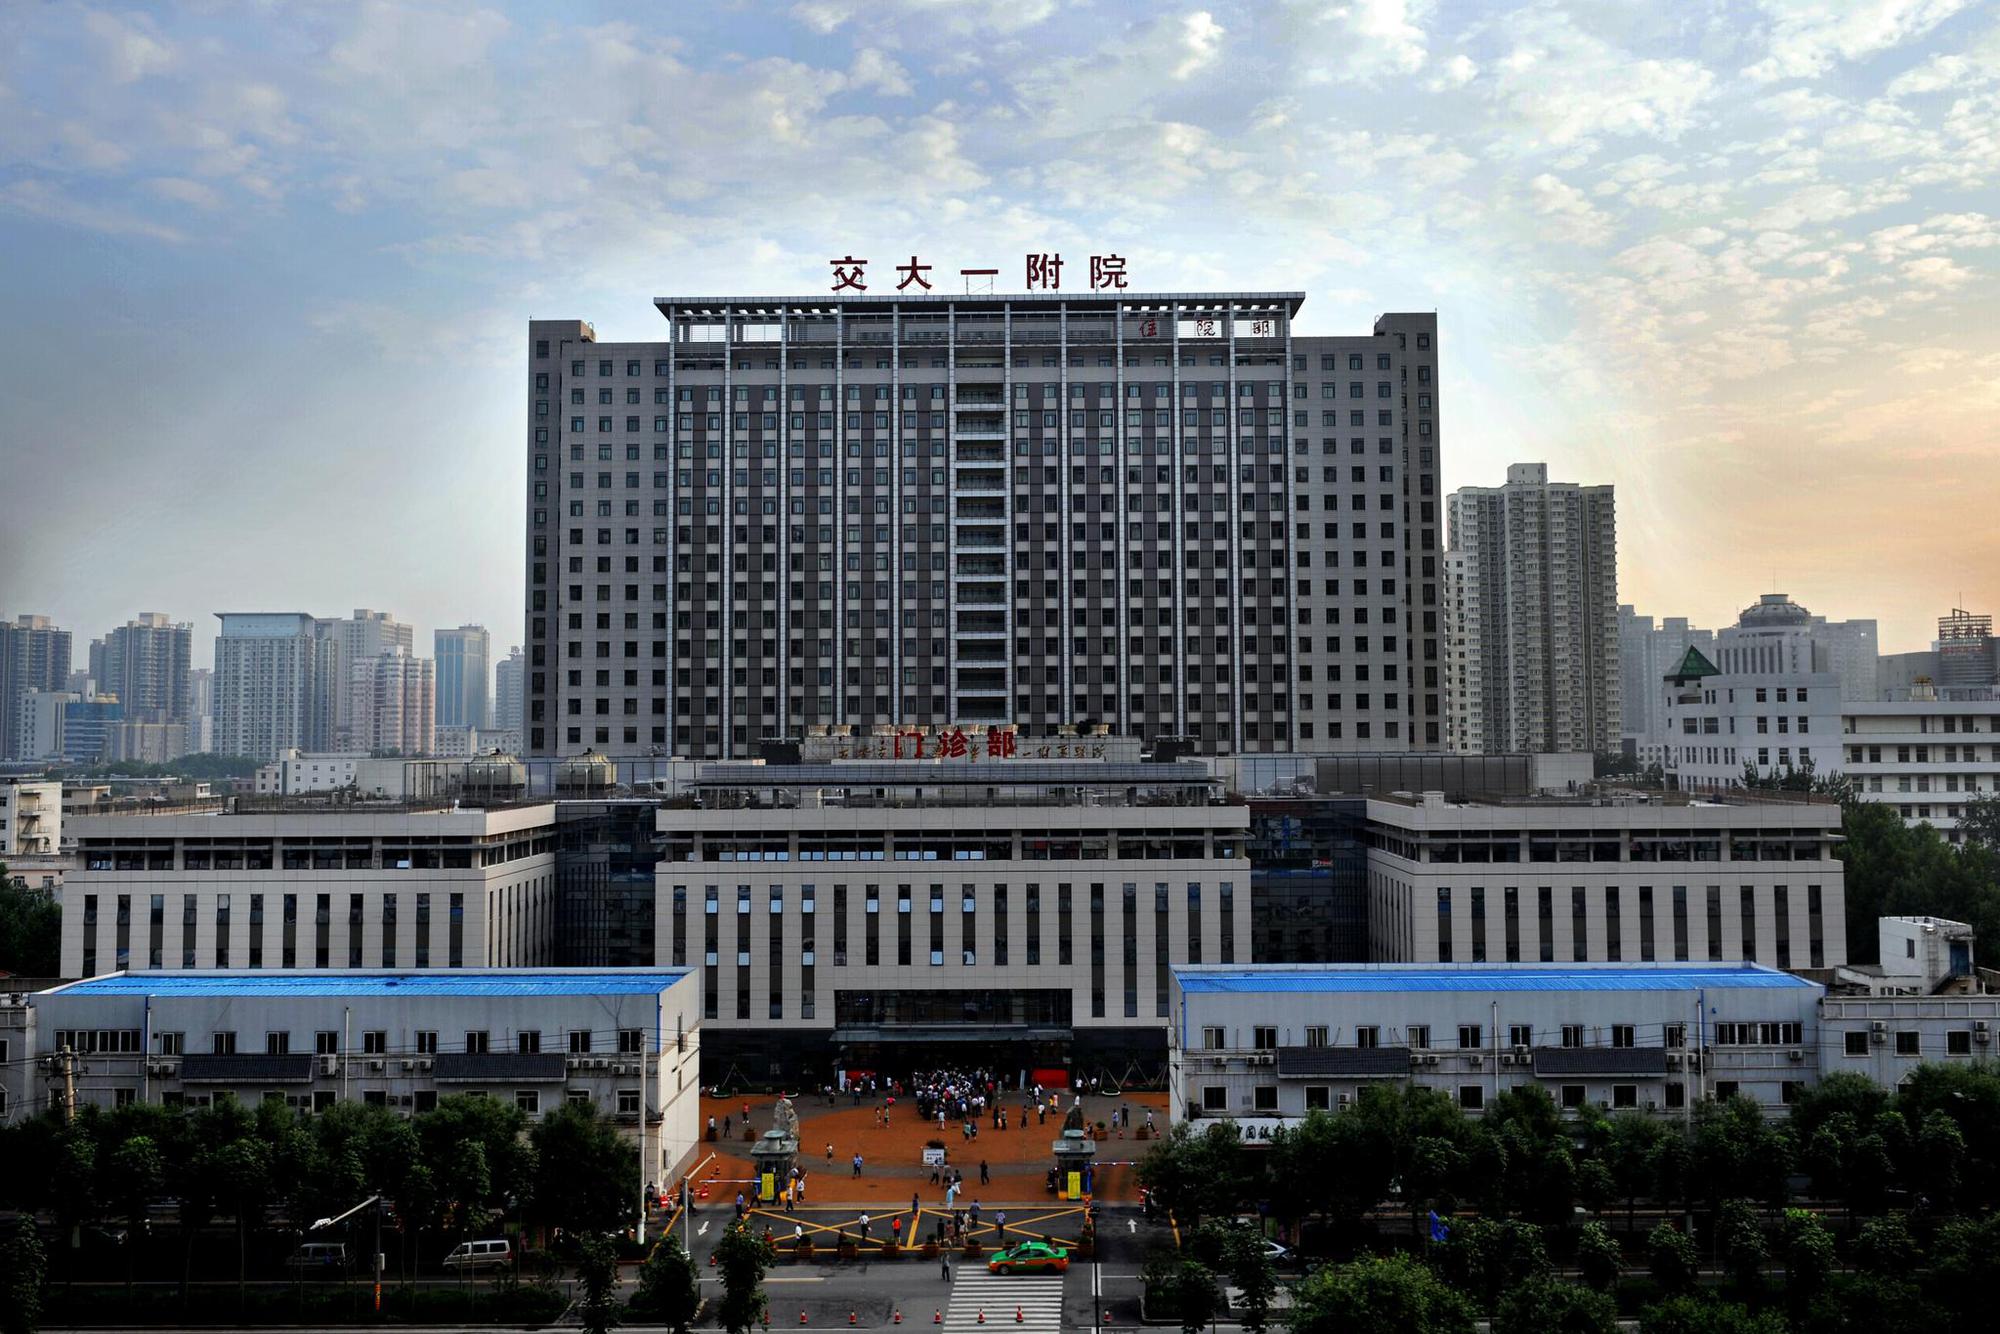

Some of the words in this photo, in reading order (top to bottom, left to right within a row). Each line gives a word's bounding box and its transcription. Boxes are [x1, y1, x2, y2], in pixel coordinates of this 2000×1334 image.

[830, 254, 1128, 290] 交大一附院
[1139, 318, 1269, 337] 住院部
[895, 726, 1016, 759] 门诊部
